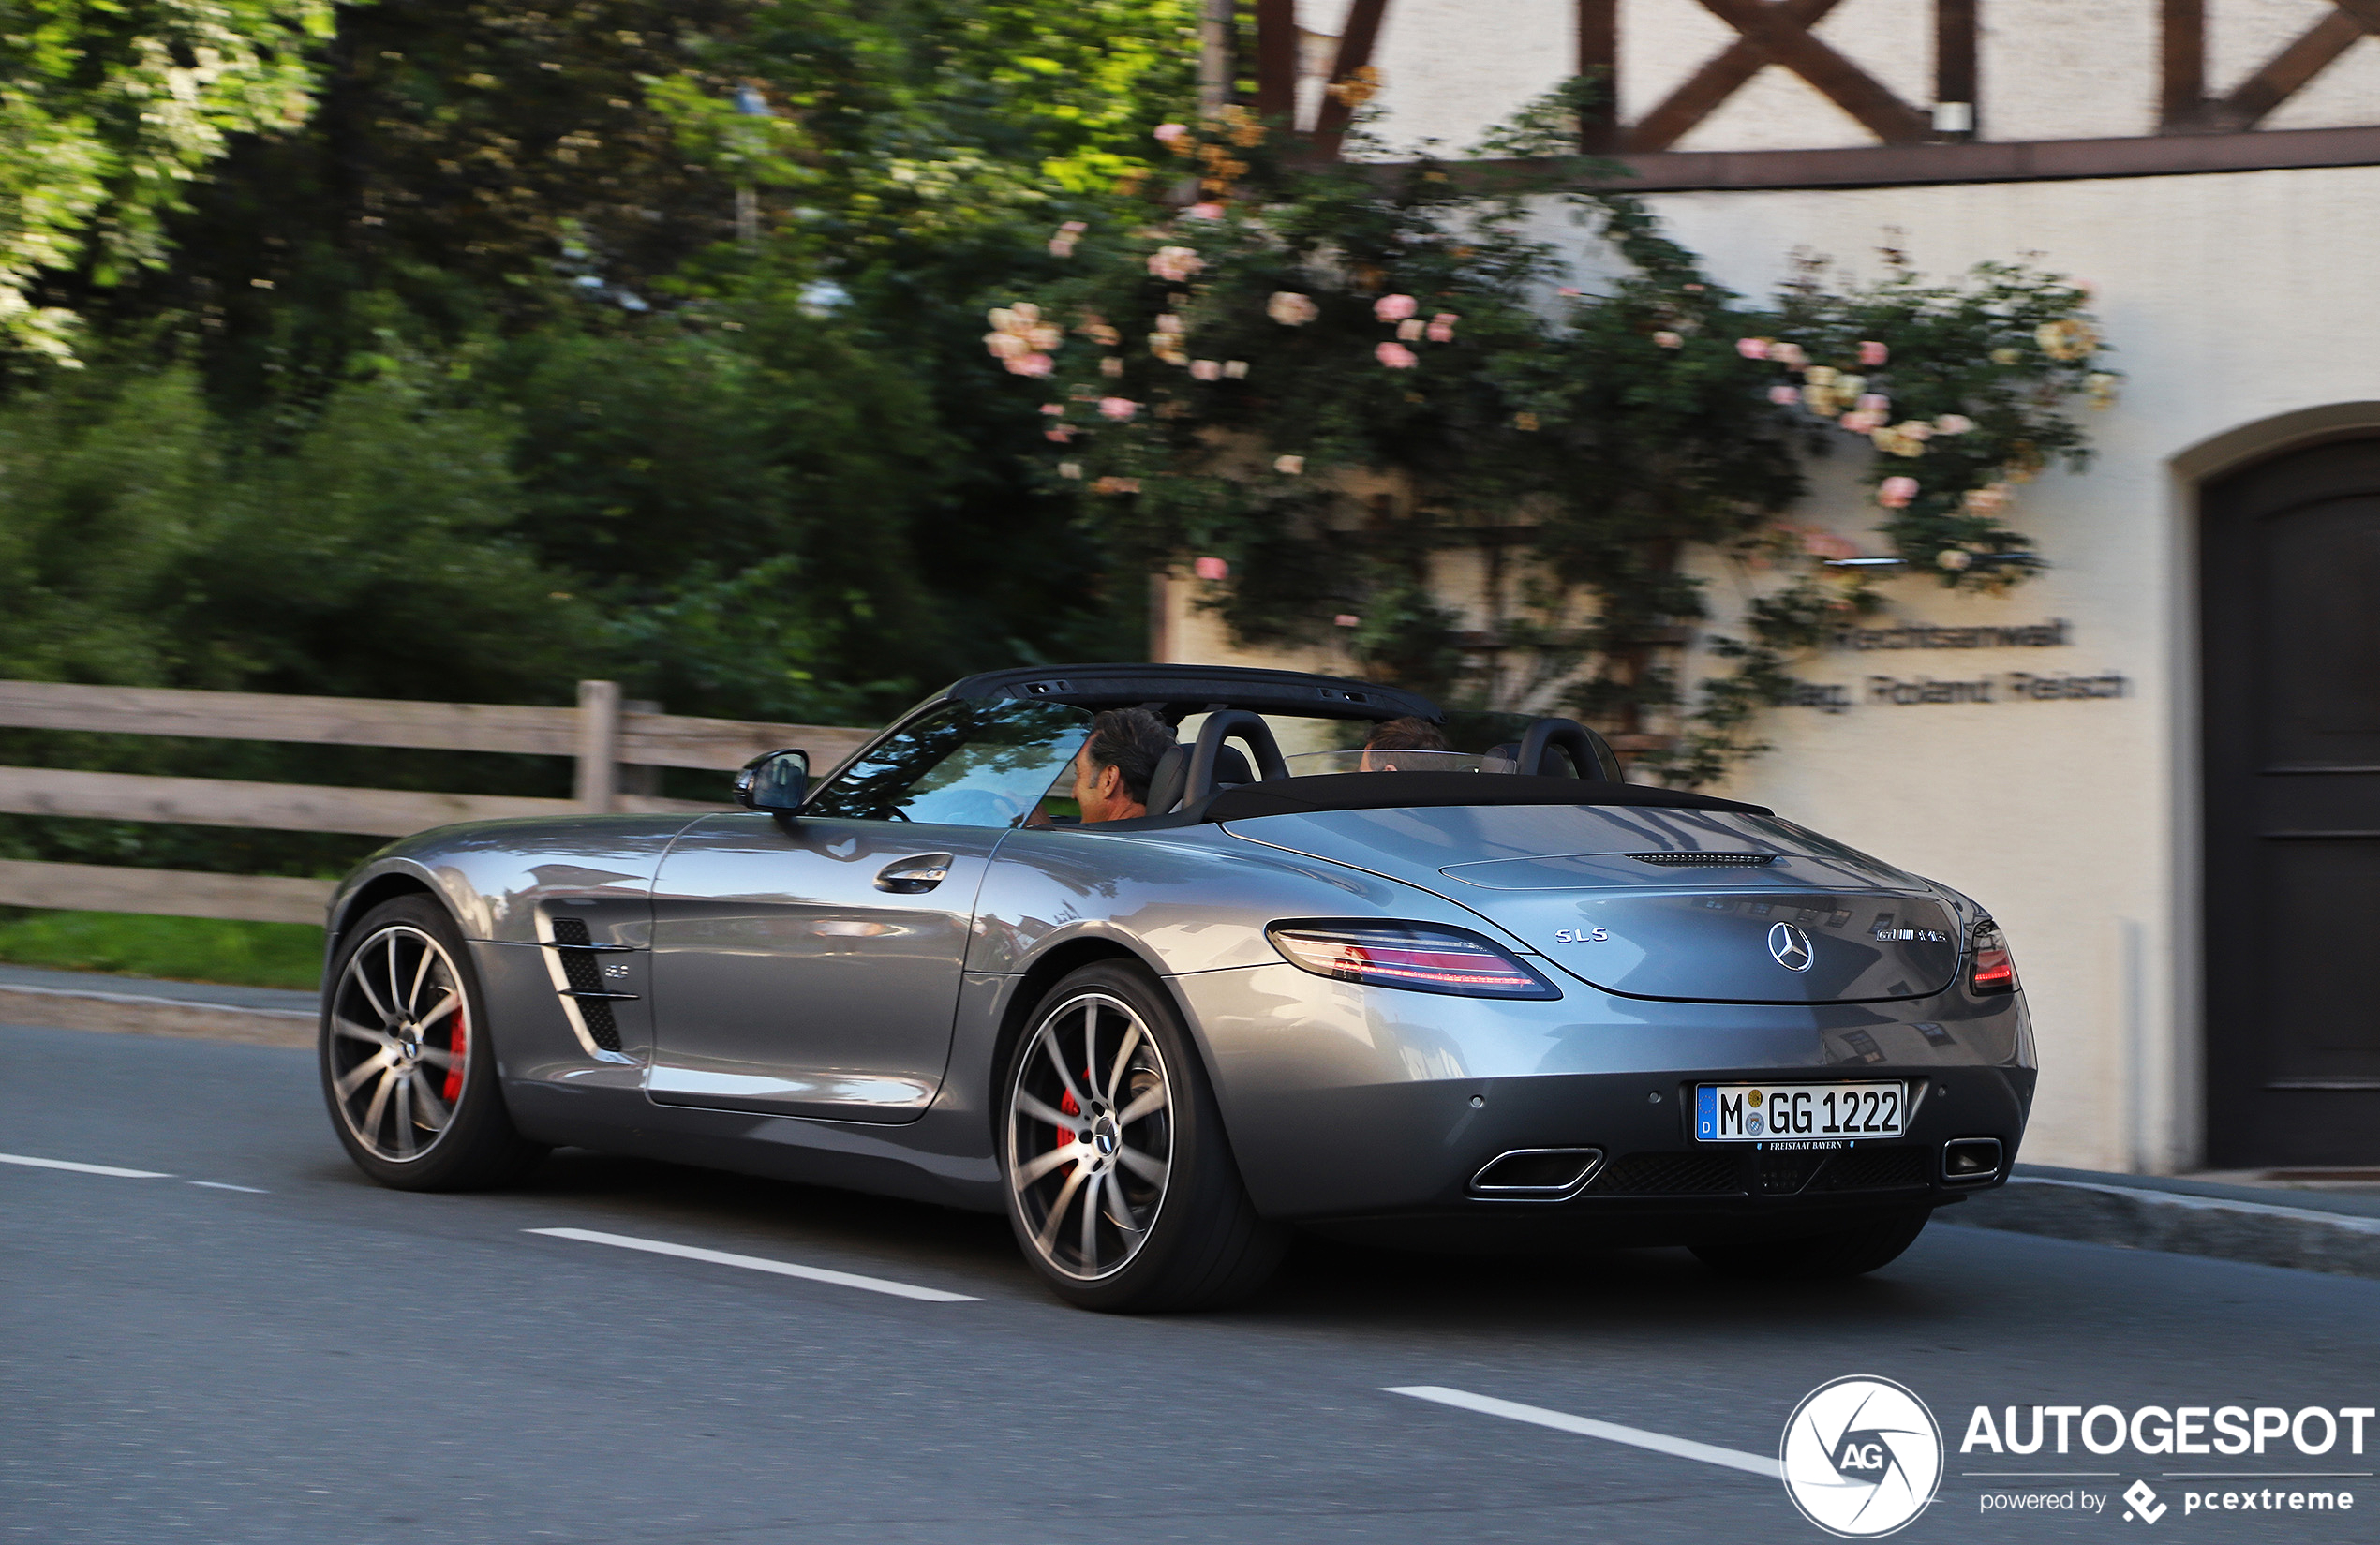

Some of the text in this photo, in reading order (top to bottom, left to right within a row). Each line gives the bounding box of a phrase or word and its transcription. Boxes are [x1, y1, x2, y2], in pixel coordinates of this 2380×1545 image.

[1554, 927, 1609, 944] SLS
[1720, 1091, 1899, 1136] M GG 1222
[1702, 1121, 1711, 1134] D
[1770, 1140, 1843, 1151] FREISTAAT BAYERN
